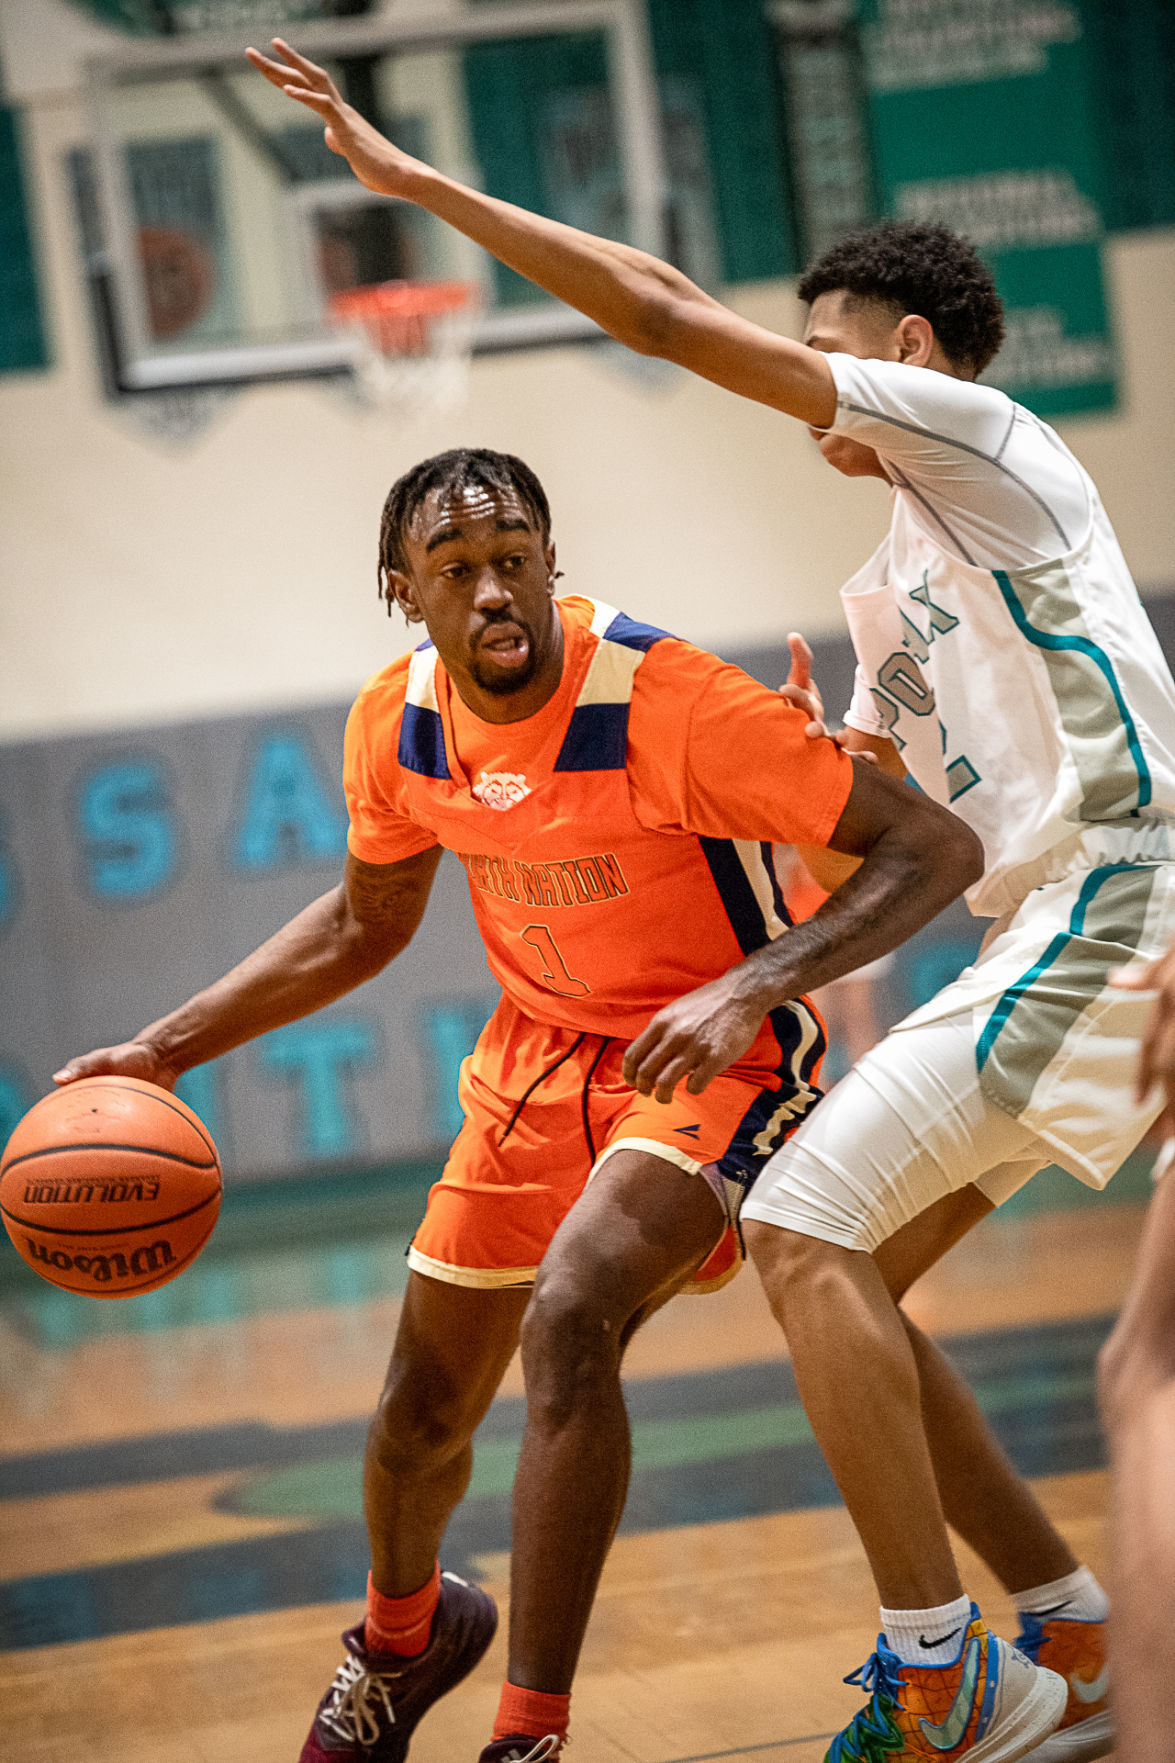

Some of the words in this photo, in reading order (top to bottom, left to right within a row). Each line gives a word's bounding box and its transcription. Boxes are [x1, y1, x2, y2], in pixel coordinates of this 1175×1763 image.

[512, 853, 630, 907] NATION
[520, 924, 592, 998] 1
[23, 1182, 160, 1204] EVOLUTION
[23, 1237, 177, 1282] Wilson
